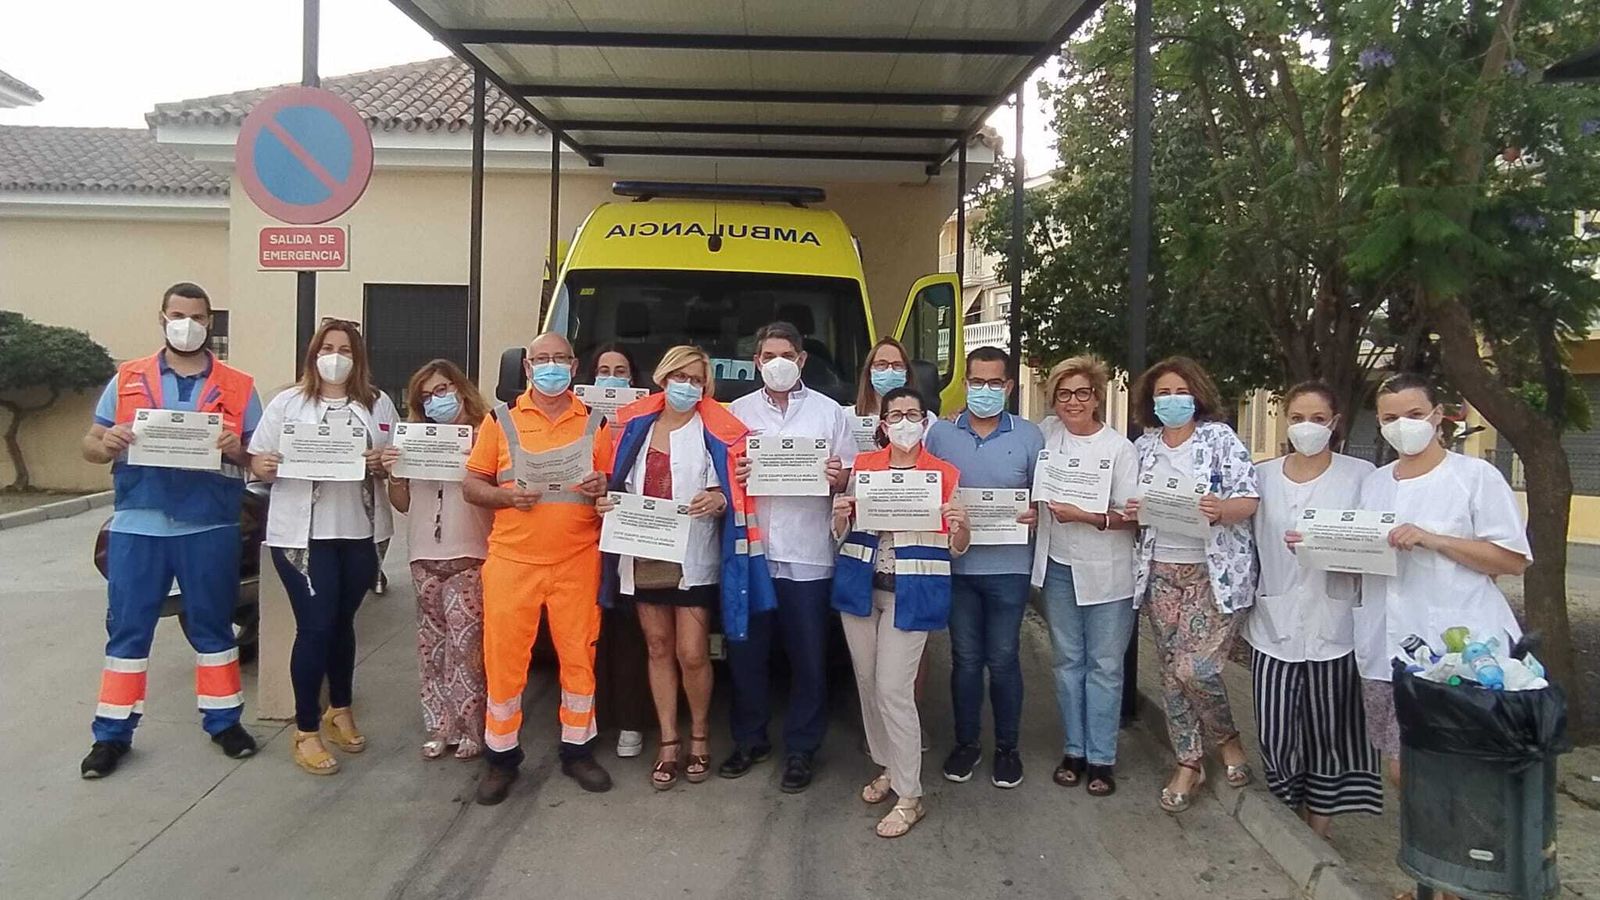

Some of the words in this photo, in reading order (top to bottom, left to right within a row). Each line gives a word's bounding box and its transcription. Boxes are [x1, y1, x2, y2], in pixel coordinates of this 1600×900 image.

[270, 234, 313, 244] SALIDA
[319, 234, 336, 244] DE
[263, 251, 341, 261] EMERGENCIA
